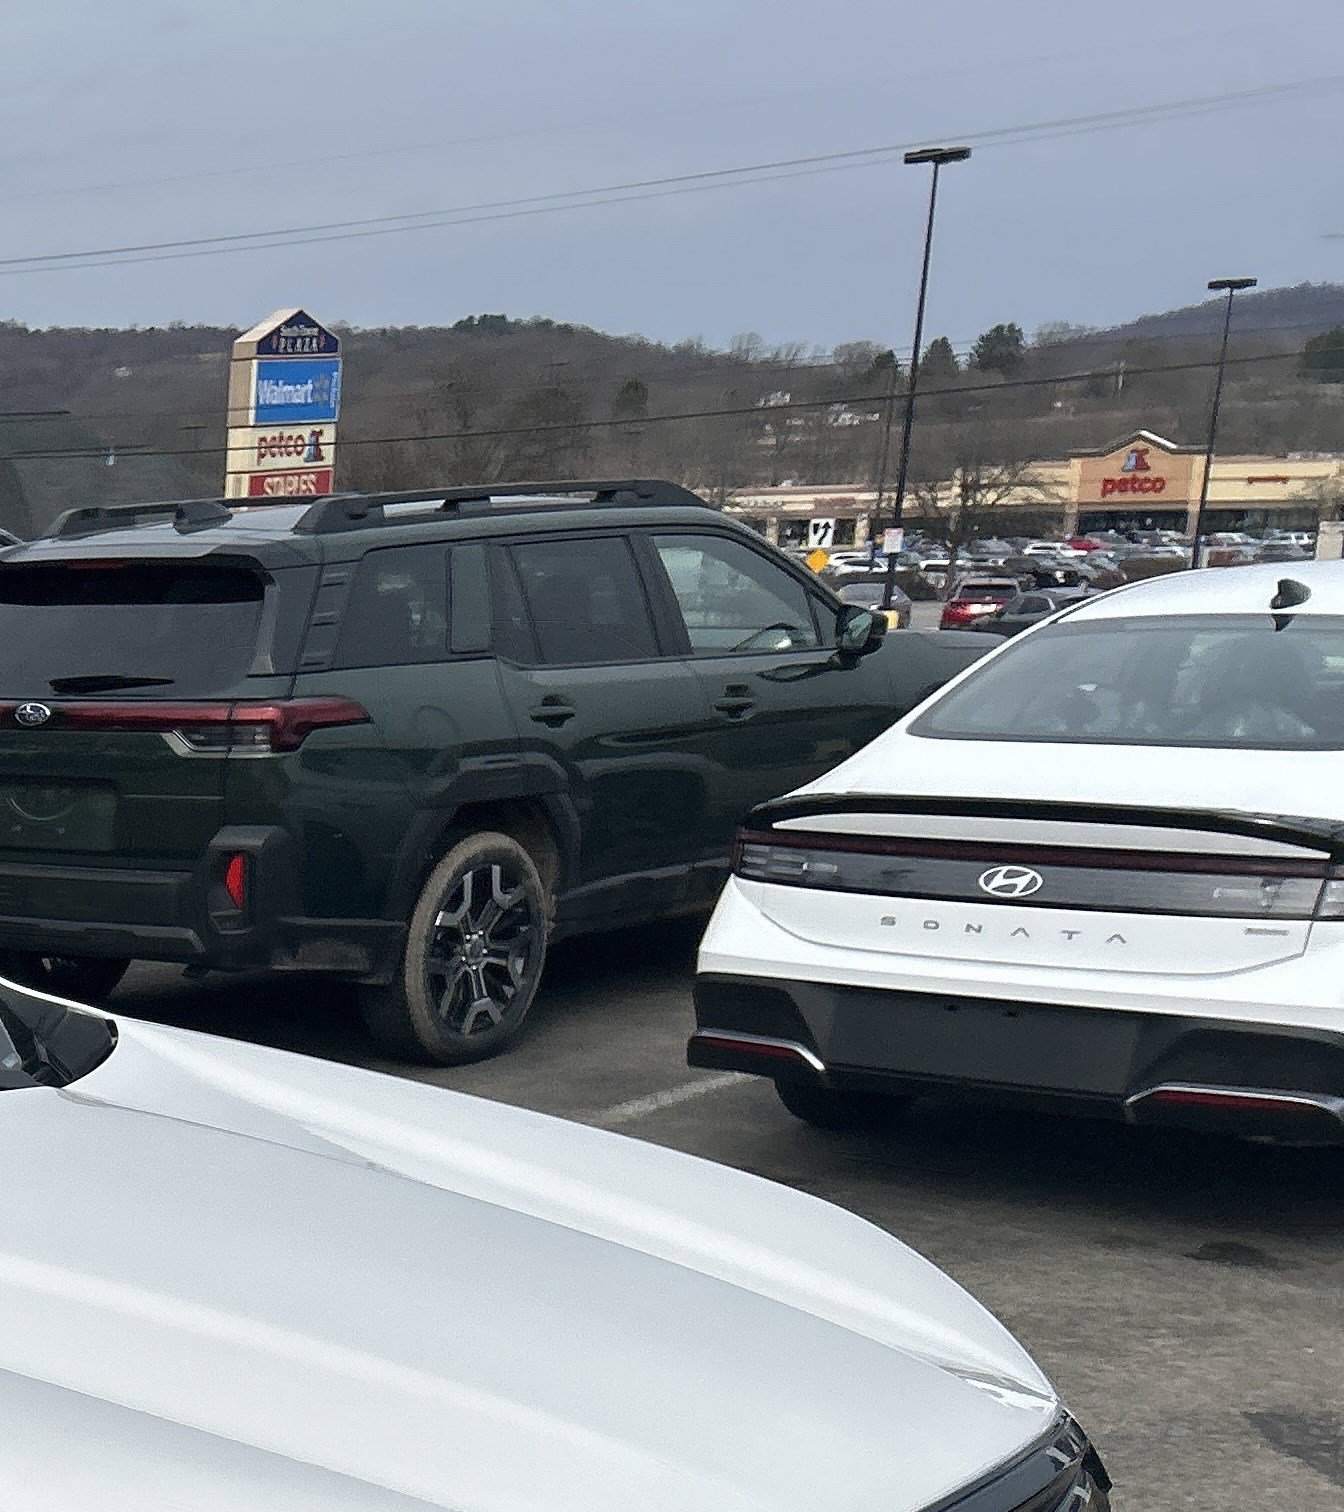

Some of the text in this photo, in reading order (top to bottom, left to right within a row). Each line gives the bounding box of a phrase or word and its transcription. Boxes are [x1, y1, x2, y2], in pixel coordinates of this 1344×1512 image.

[257, 379, 313, 405] Walmart
[257, 432, 304, 465] petco
[1100, 474, 1166, 499] petco
[879, 916, 1128, 945] SONATA
